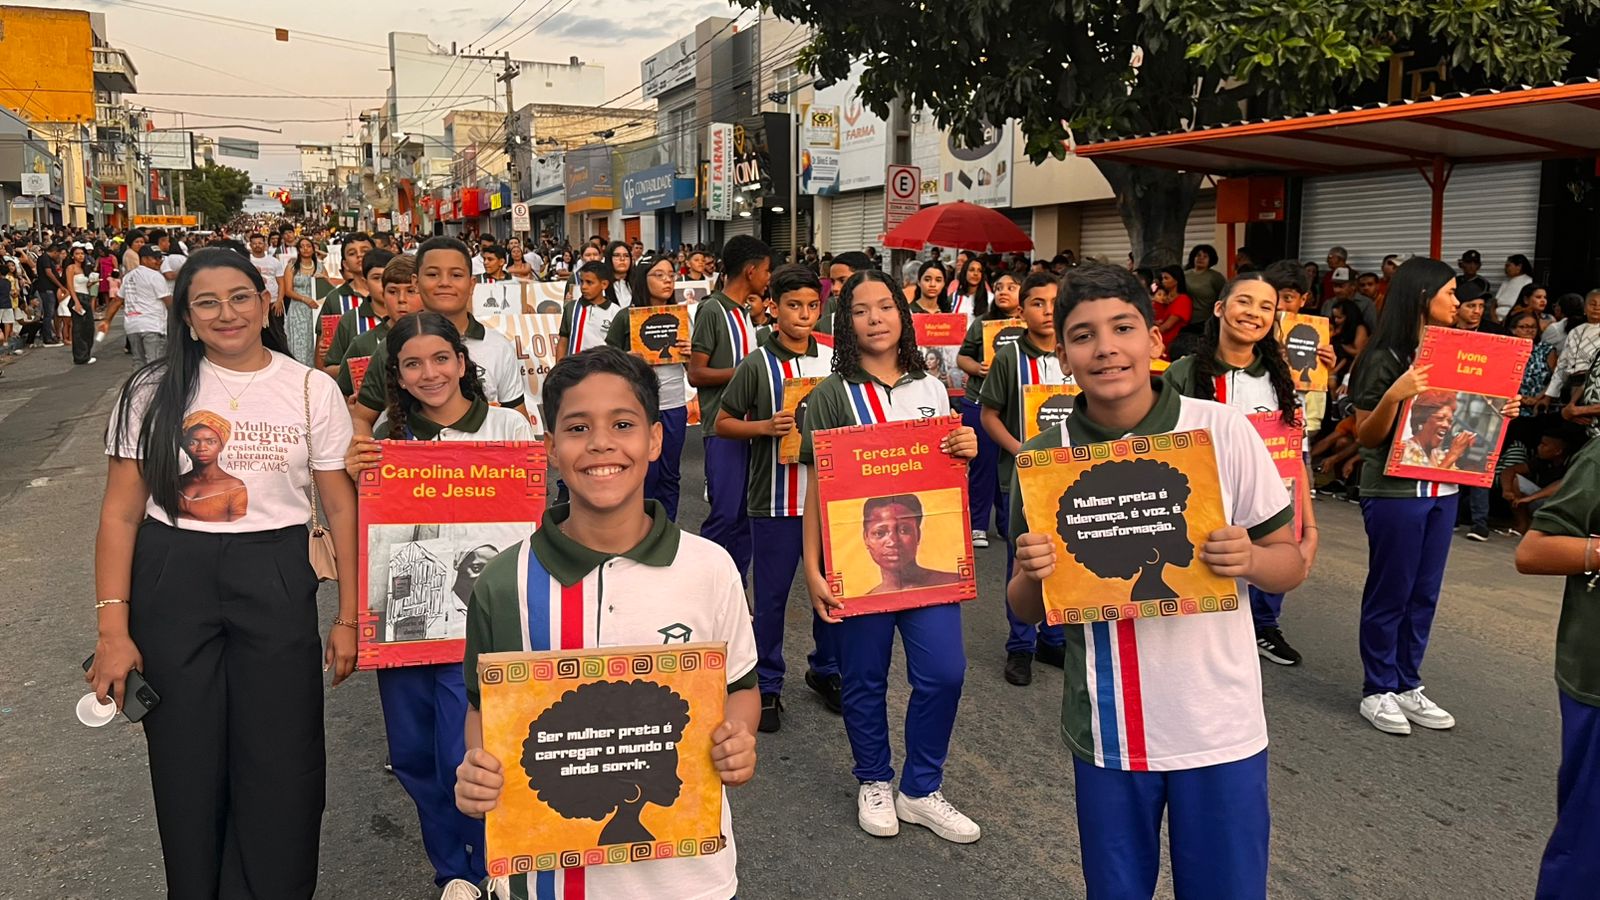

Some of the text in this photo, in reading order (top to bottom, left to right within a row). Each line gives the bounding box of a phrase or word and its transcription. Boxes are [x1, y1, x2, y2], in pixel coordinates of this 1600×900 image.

[900, 176, 908, 191] E
[926, 329, 950, 337] Franco
[1457, 350, 1488, 364] Ivone
[528, 367, 534, 375] e
[1456, 363, 1483, 377] Lara
[235, 421, 300, 434] Mulheres
[234, 431, 300, 445] negras
[852, 442, 929, 461] Tereza de
[226, 460, 290, 473] AFRICANAS
[381, 464, 527, 479] Carolina Maria
[861, 459, 923, 476] Bengela
[413, 483, 496, 498] de Jesus
[1073, 488, 1168, 508] Mulher preta é
[1066, 511, 1128, 525] liderança,
[1131, 507, 1139, 519] é
[1172, 503, 1181, 514] é
[1077, 521, 1176, 540] transformação.
[537, 722, 673, 744] Ser mulher preta é
[535, 740, 674, 761] carregar o mundo e
[560, 758, 650, 776] ainda sorrir.
